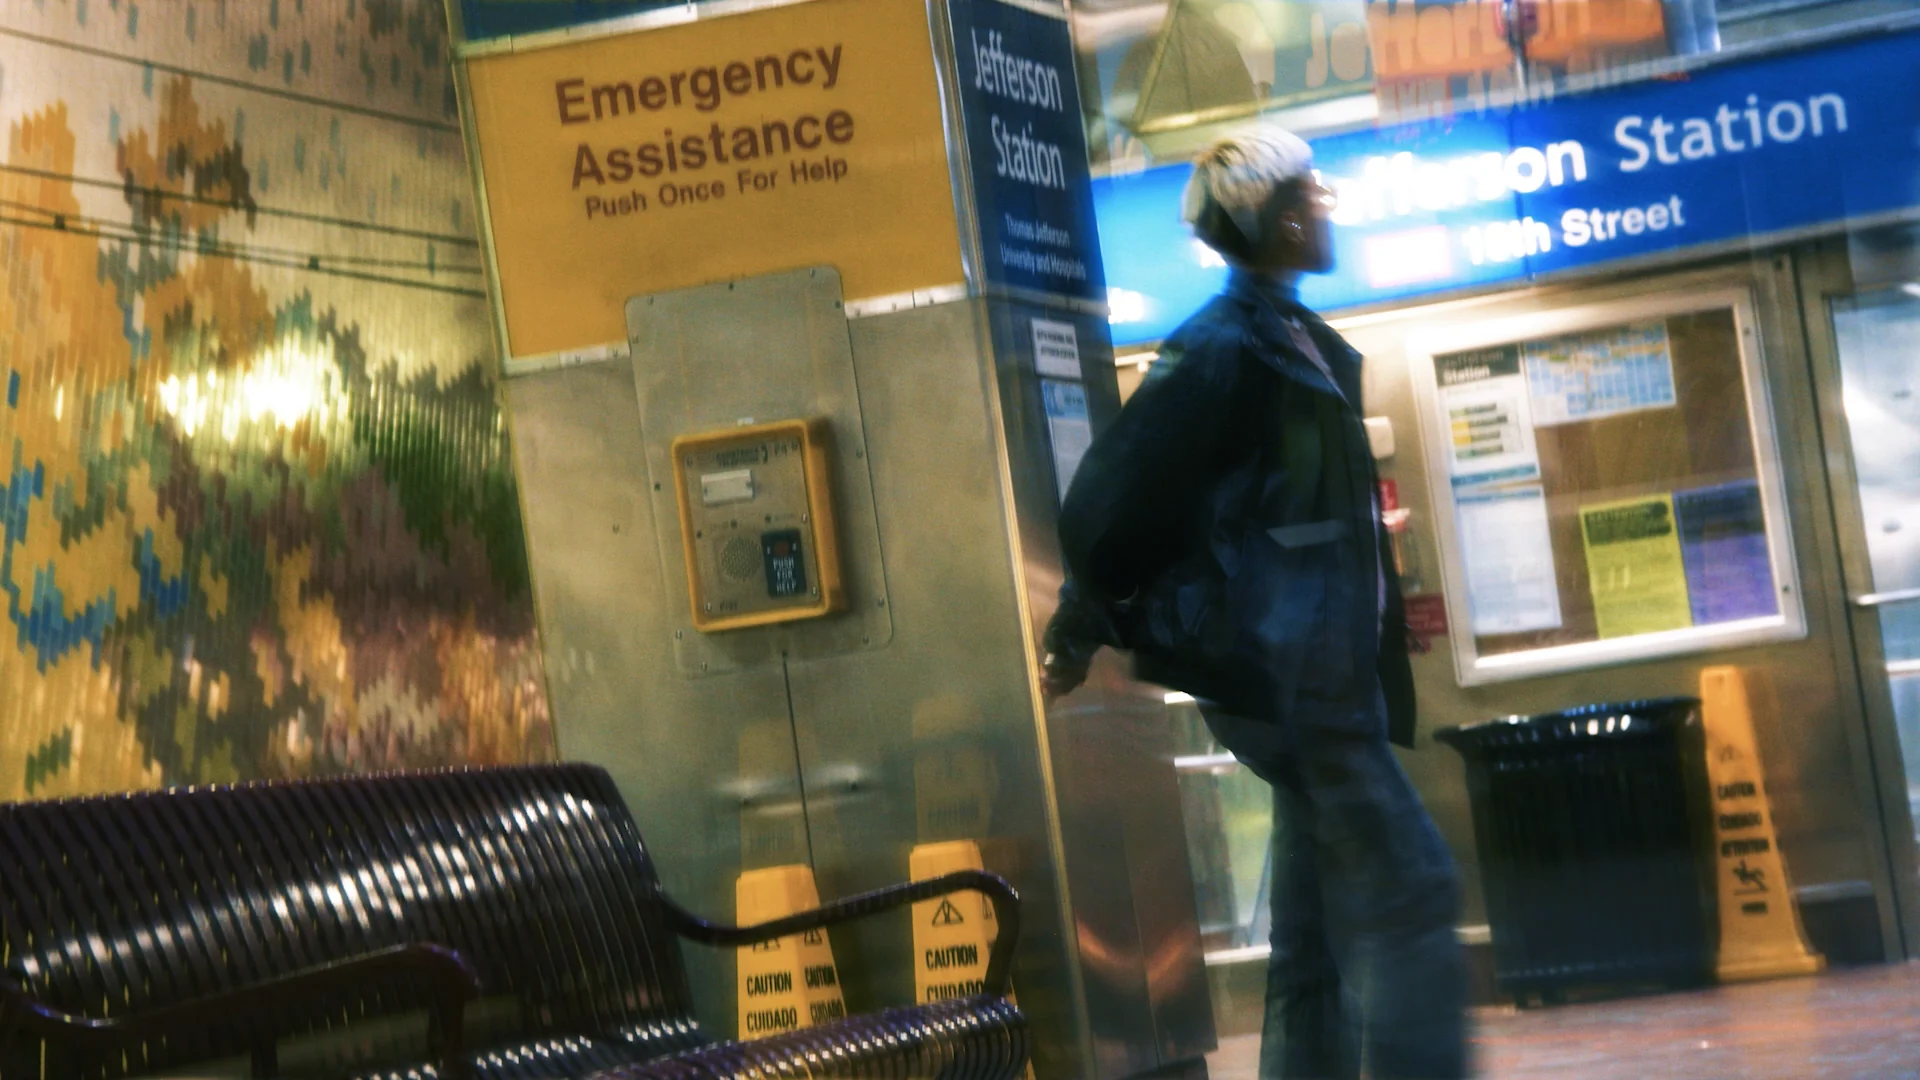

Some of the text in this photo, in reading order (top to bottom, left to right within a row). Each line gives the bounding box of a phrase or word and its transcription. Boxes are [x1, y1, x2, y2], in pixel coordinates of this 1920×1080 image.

[555, 43, 842, 125] Emergency
[970, 26, 1063, 112] Jefferson
[571, 109, 854, 190] Assistance
[990, 113, 1066, 191] Station
[1614, 93, 1848, 172] Station
[585, 155, 848, 219] Push Once For Help
[1561, 194, 1685, 247] Street
[746, 971, 793, 997] CAUTION
[925, 944, 979, 971] CAUTION
[746, 1004, 798, 1033] CUIDADO
